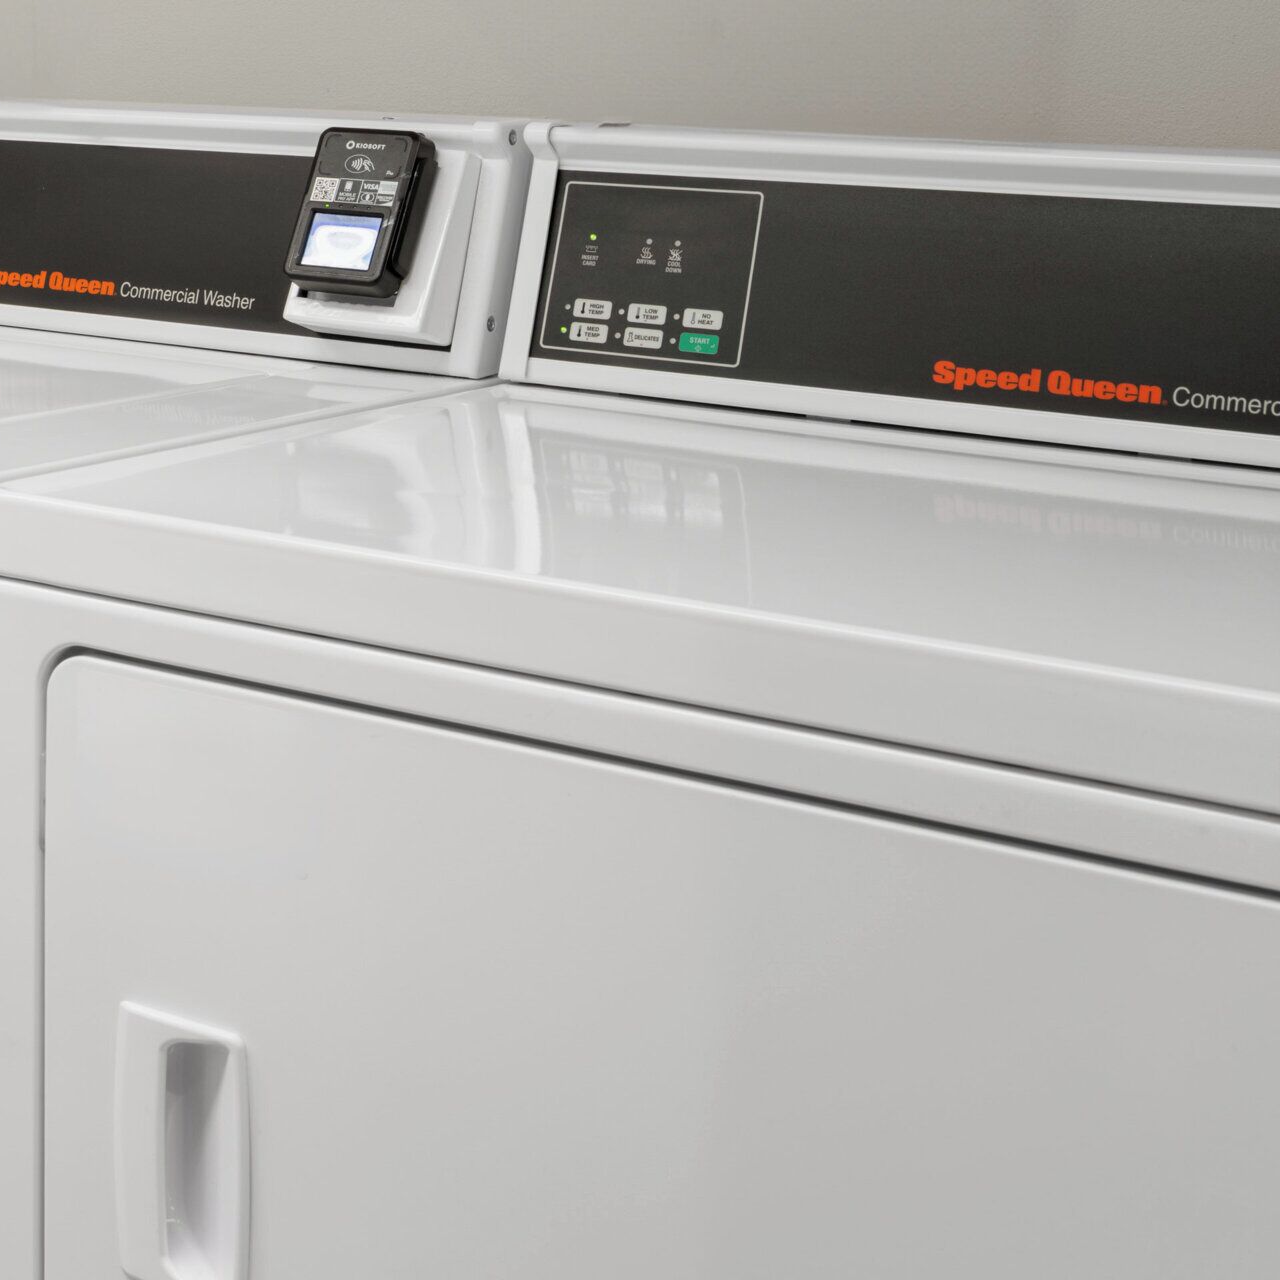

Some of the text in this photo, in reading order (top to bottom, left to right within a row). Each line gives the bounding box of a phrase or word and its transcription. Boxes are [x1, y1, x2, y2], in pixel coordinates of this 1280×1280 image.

[48, 272, 116, 296] Queen
[120, 282, 198, 304] Commercial
[204, 290, 256, 310] Washer
[932, 360, 1280, 416] Speed Queen Commerc
